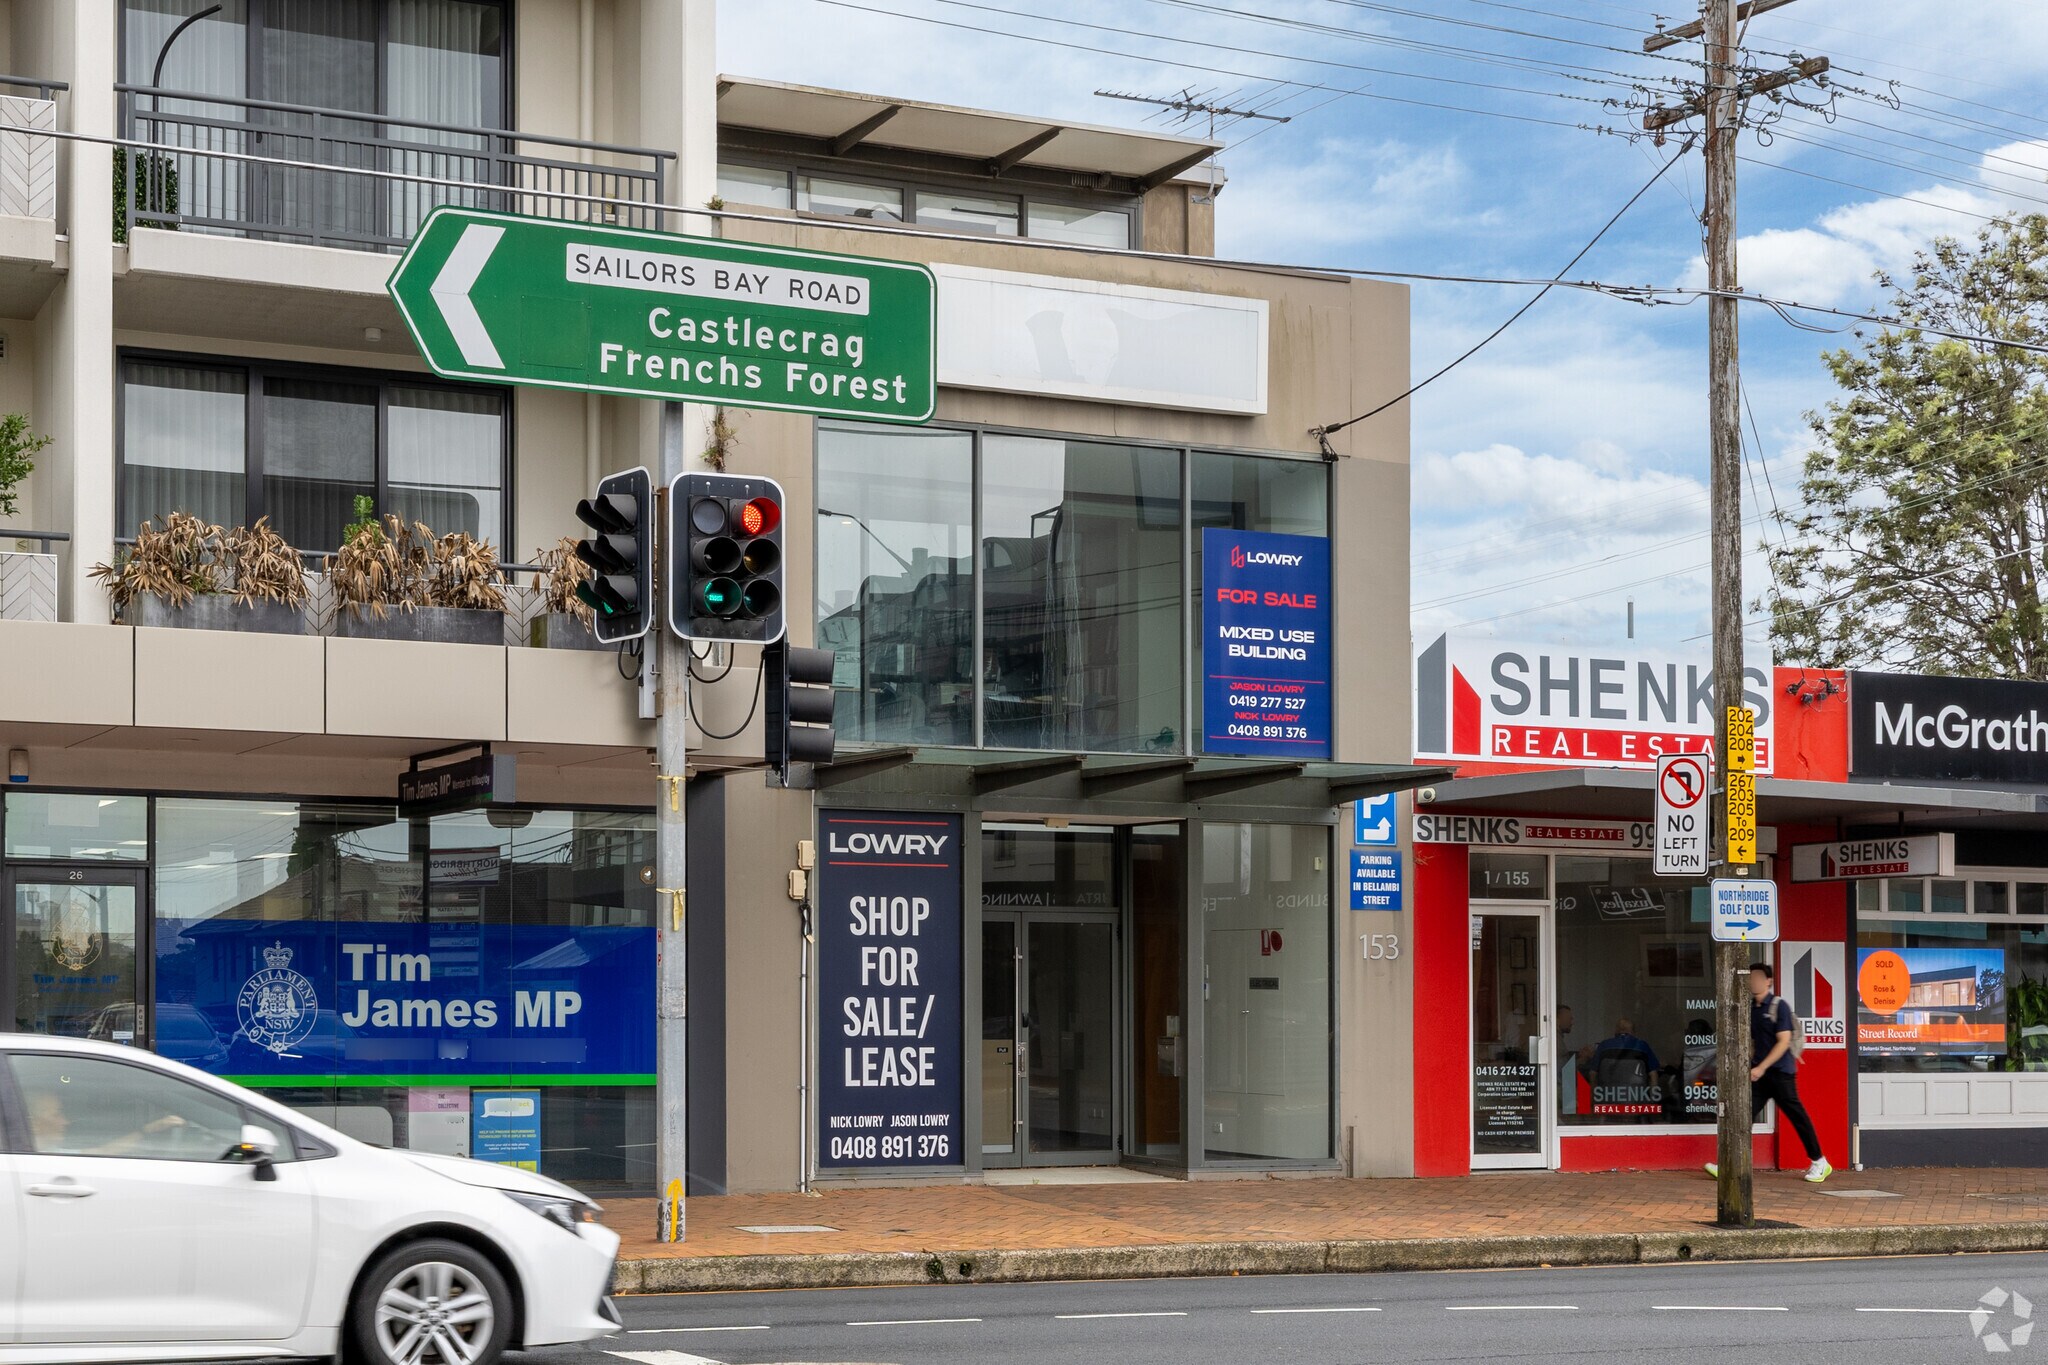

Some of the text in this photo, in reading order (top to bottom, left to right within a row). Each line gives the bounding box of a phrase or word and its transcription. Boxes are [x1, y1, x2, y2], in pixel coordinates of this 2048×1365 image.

[574, 252, 862, 306] SAILORS BAY ROAD
[648, 306, 864, 369] Castlecrag
[600, 342, 907, 404] Frenchs Forest
[1247, 551, 1303, 567] LOWRY
[1217, 588, 1317, 609] FOR SALE
[1219, 625, 1315, 644] MIXED USE
[1228, 644, 1307, 661] BUILDING
[1229, 682, 1306, 694] JASON LOWRY
[1229, 694, 1306, 710] 0419 277 527
[1234, 711, 1300, 723] NICK LOWRY
[1728, 709, 1753, 723] 202
[1228, 724, 1307, 739] 0408 891 376
[1728, 723, 1754, 737] 204
[1875, 701, 2048, 753] McGrath
[1494, 727, 1766, 765] REAL ESTAE
[1728, 737, 1754, 751] 208
[402, 782, 415, 803] Tim
[416, 779, 439, 800] James
[440, 773, 451, 795] MP
[1728, 774, 1753, 788] 267
[1728, 788, 1754, 802] 203
[1728, 802, 1754, 816] 205
[1417, 815, 1520, 844] SHENKS
[1525, 827, 1563, 839] REAL
[1570, 828, 1624, 840] ESTATE
[1667, 814, 1695, 832] NO
[1735, 817, 1747, 828] To
[1729, 828, 1755, 842] 209
[828, 832, 949, 856] LOWRY
[1663, 837, 1698, 851] LEFT
[1839, 840, 1909, 863] SHENKS
[1360, 855, 1392, 865] PARKING
[1662, 854, 1699, 867] TURN
[69, 871, 83, 880] 26
[1356, 868, 1396, 878] AVAILABLE
[1840, 863, 1909, 876] REAL ESTATE
[1484, 870, 1491, 885] 1
[1504, 871, 1530, 885] 155
[1353, 882, 1400, 892] IN BELLAMBI
[1362, 895, 1391, 905] STREET
[1718, 890, 1769, 902] NORTHBRIDGE
[849, 896, 931, 936] SHOP
[1719, 903, 1770, 916] GOLF CLUB
[1359, 933, 1400, 960] 153
[342, 944, 431, 982] Tim
[861, 946, 919, 986] FOR
[1875, 960, 1894, 968] SOLD
[240, 970, 316, 1008] PARLIAMENT
[1873, 985, 1896, 993] Rose &
[342, 989, 583, 1028] James MP
[1873, 997, 1896, 1005] Denise
[843, 994, 935, 1039] SALE/
[264, 1019, 295, 1030] NSW
[1684, 1034, 1718, 1045] CONSU
[1859, 1028, 1918, 1039] Street Record
[844, 1046, 936, 1087] LEASE
[1476, 1066, 1536, 1076] 0416 274 327
[1593, 1086, 1662, 1102] SHENKS
[1684, 1085, 1718, 1100] 9958
[1624, 1105, 1662, 1113] ESTATE
[830, 1113, 949, 1128] NICK LOWRY JASON LOWRY
[830, 1134, 949, 1160] 0408 891 376
